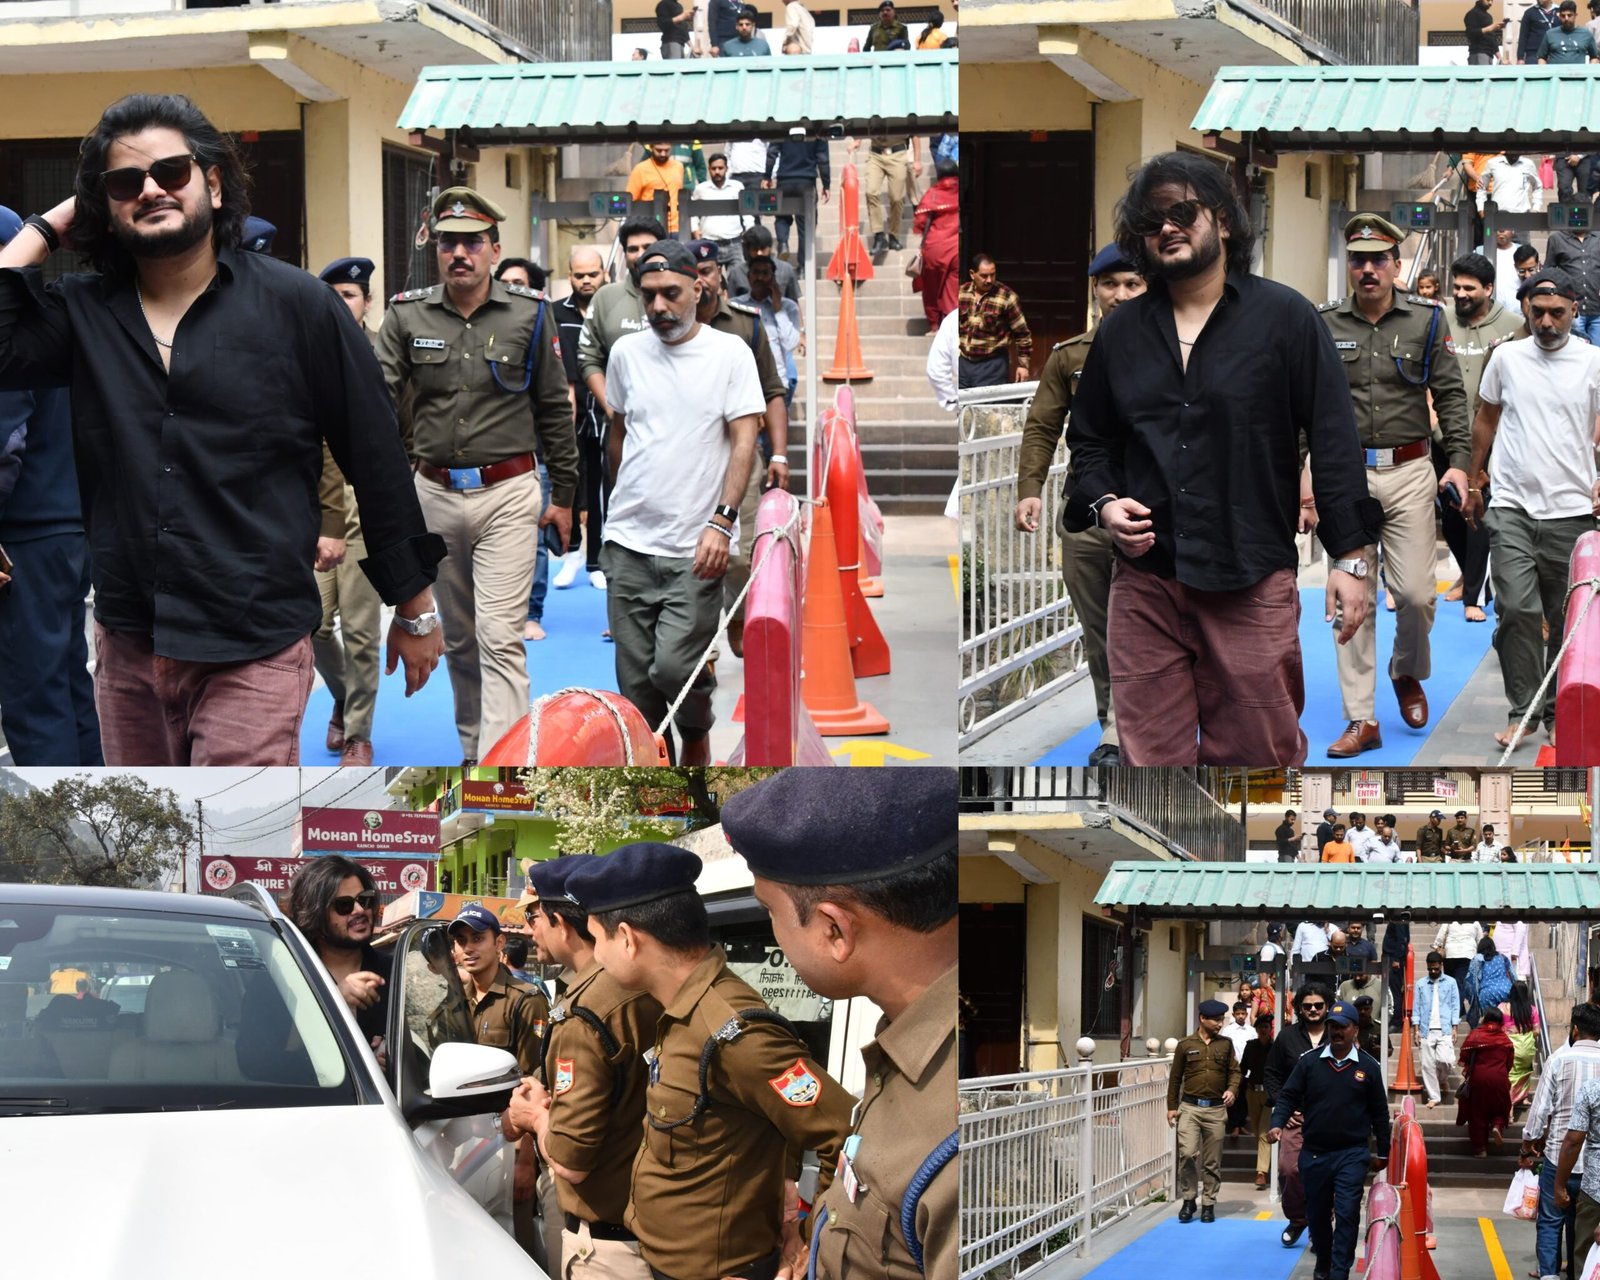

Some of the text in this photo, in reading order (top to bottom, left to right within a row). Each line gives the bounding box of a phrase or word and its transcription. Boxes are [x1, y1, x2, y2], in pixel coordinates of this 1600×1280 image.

[1357, 789, 1378, 797] ENTRY
[1436, 788, 1456, 796] EXIT
[254, 859, 273, 872] श्री
